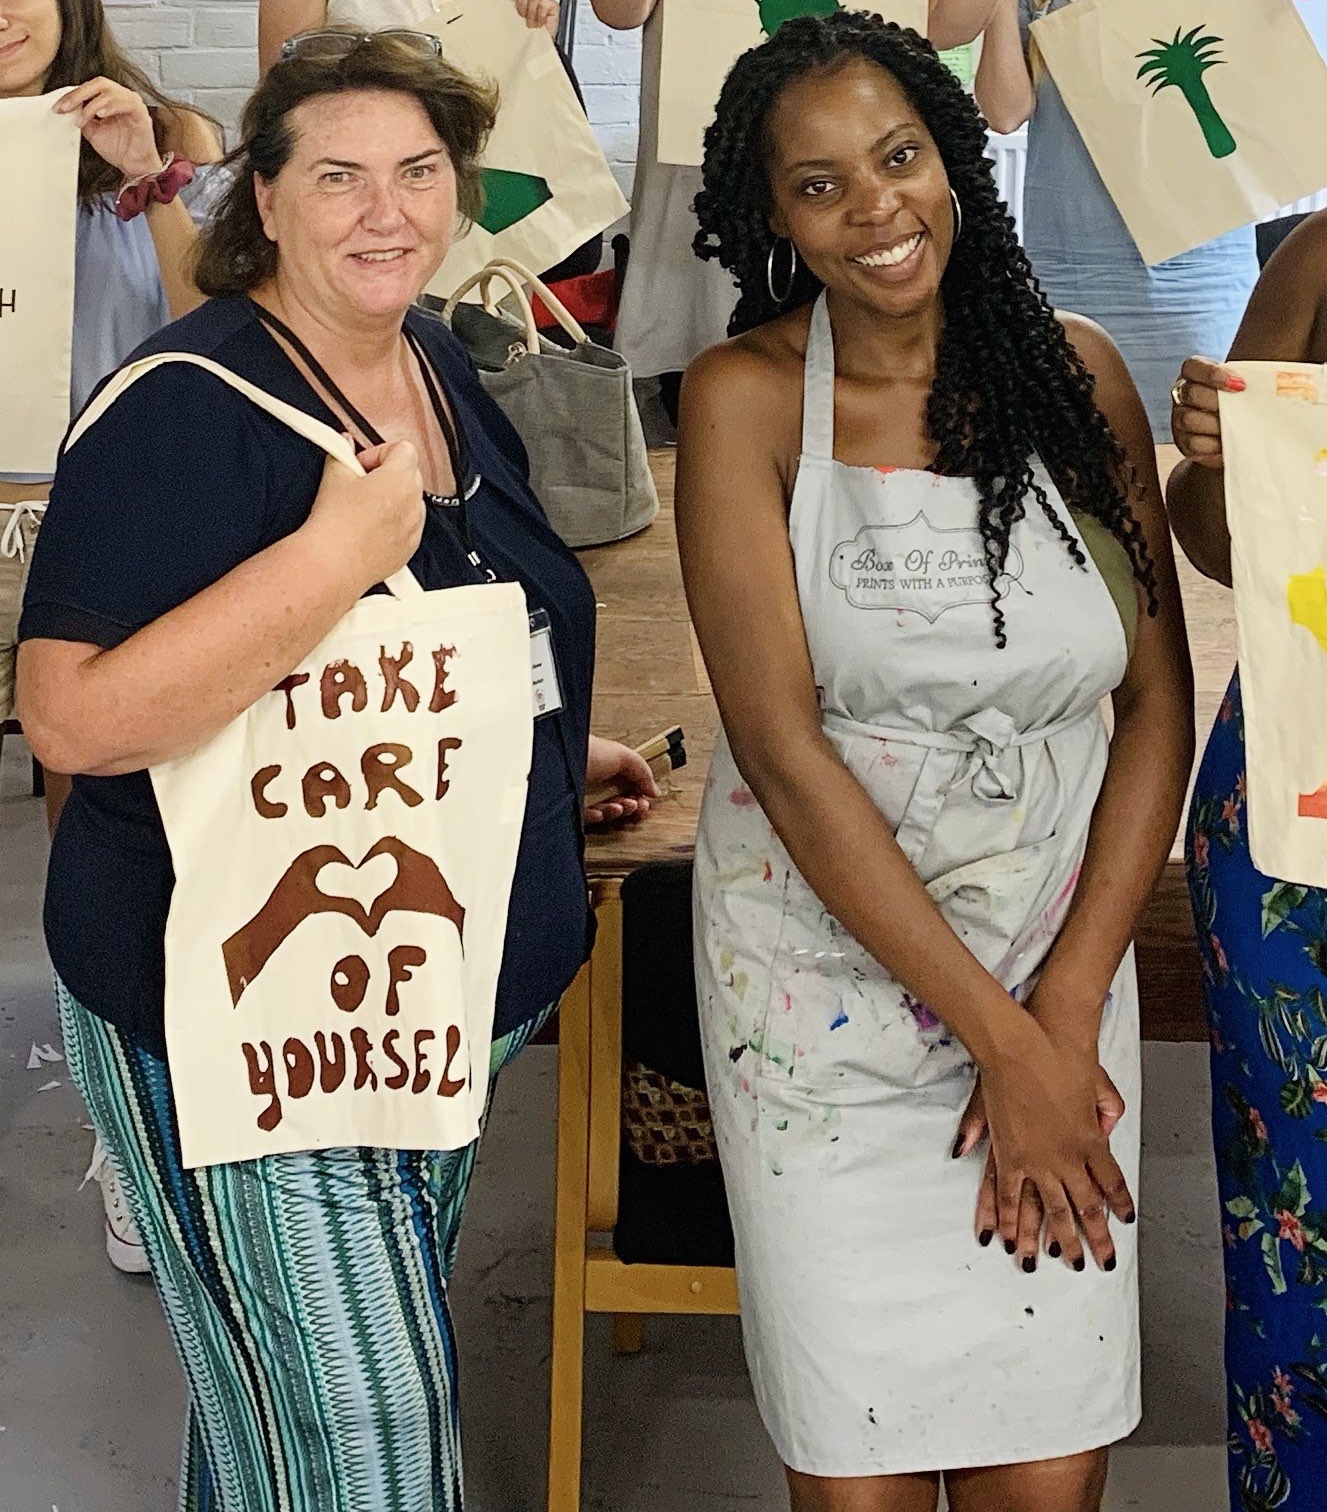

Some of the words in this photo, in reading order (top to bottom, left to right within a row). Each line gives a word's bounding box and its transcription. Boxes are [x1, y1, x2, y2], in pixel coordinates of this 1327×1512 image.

[850, 548, 894, 572] Box
[904, 549, 934, 574] Of
[938, 550, 986, 571] Prin
[856, 577, 895, 590] PRINTS
[899, 578, 932, 590] WITH
[936, 578, 945, 589] A
[947, 575, 991, 587] PURPOS
[272, 640, 458, 730] TAKE
[250, 736, 463, 820] CARE
[330, 945, 426, 1016] OF
[241, 1024, 473, 1132] YOURSEL
